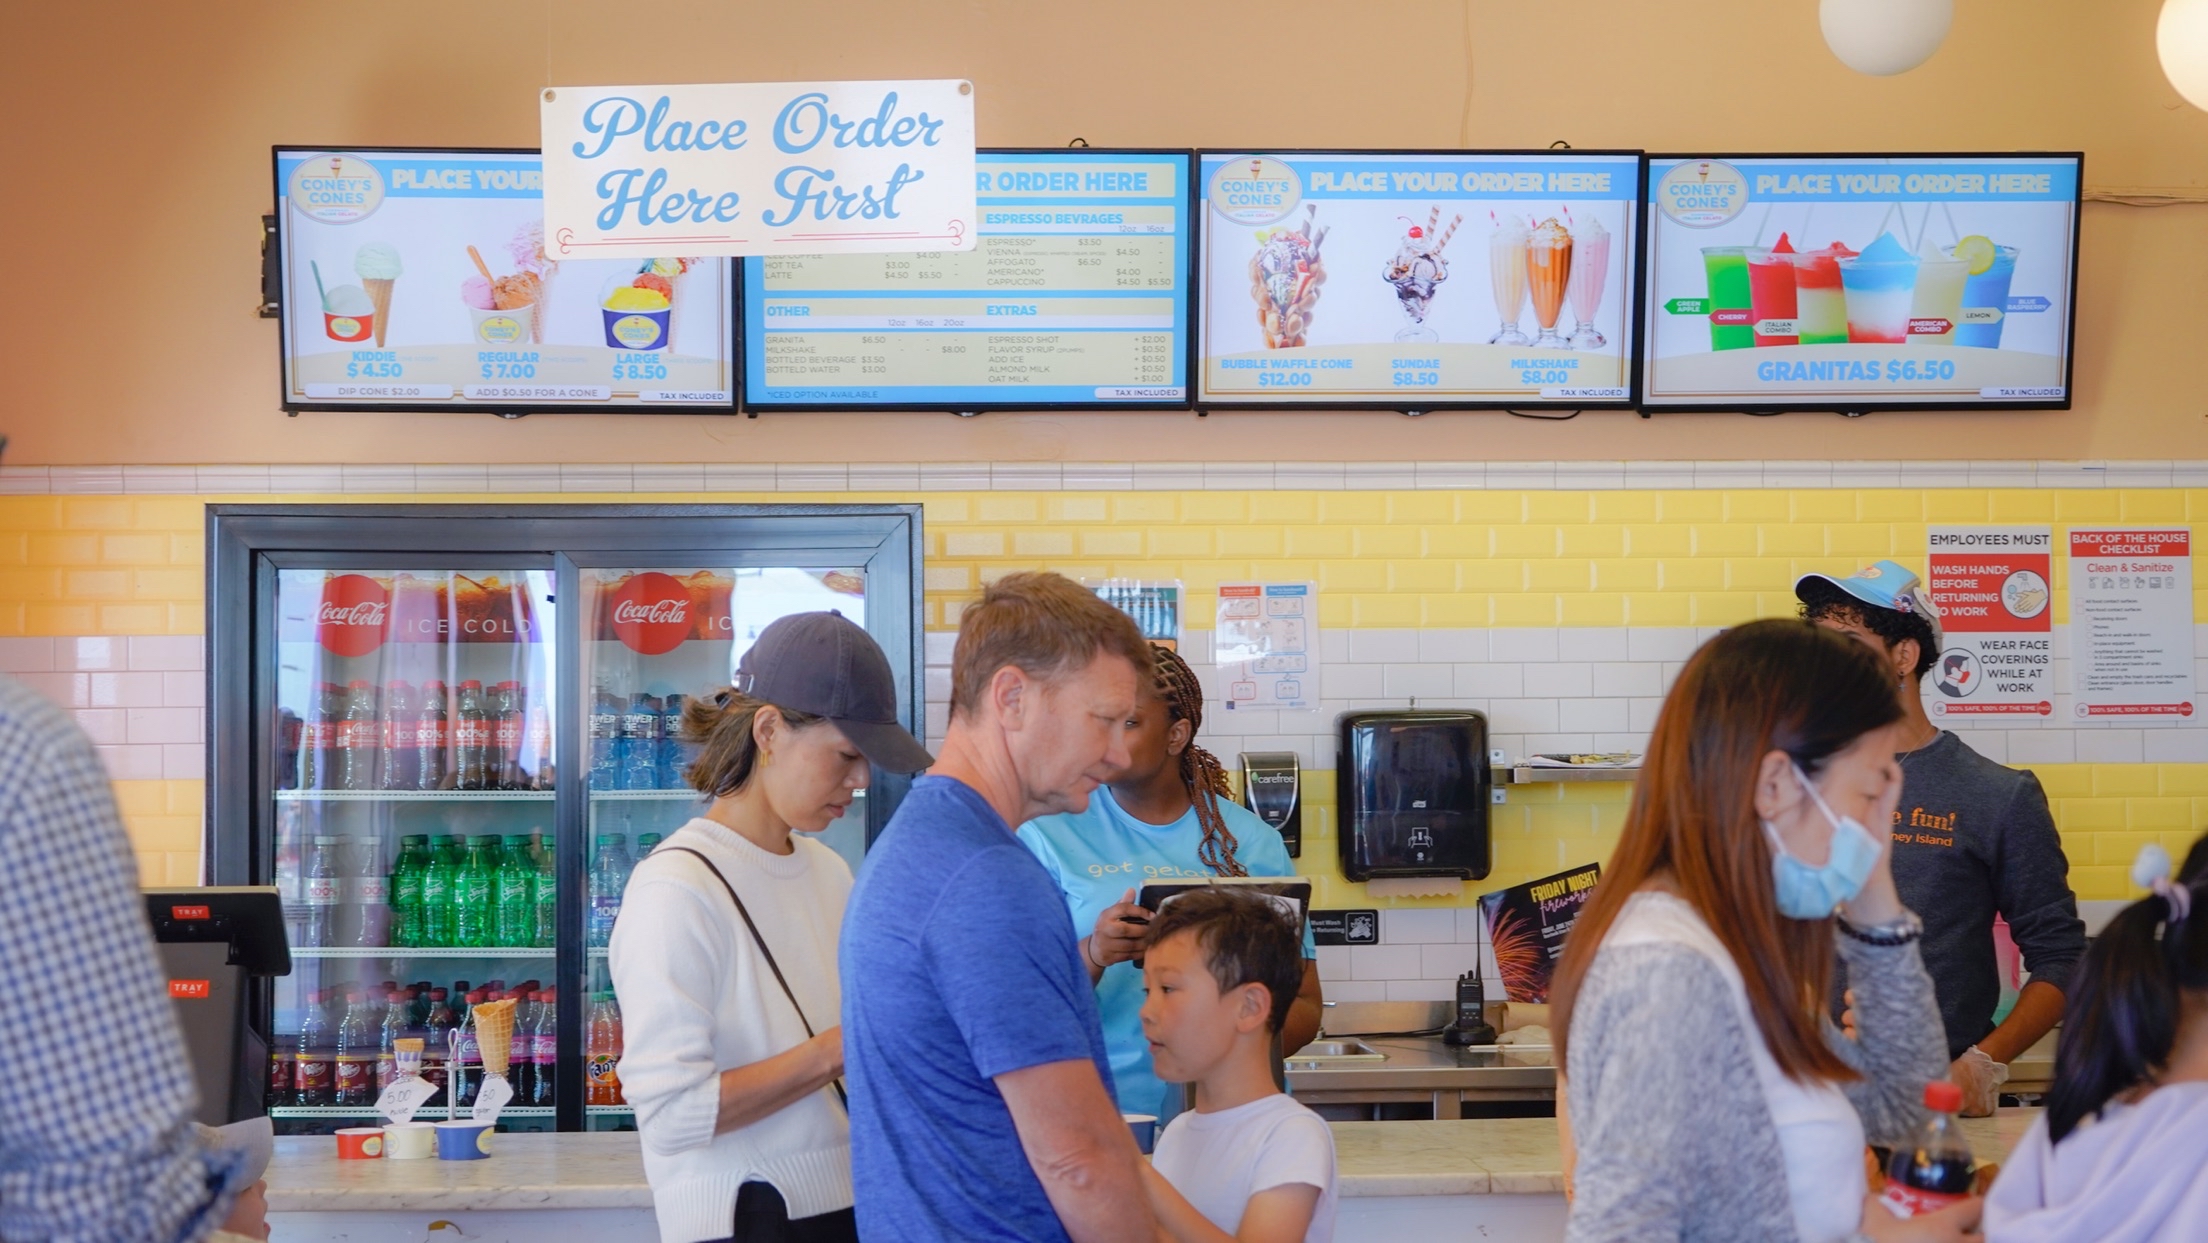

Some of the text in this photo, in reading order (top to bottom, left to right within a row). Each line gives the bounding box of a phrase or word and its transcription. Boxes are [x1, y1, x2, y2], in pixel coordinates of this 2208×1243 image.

[572, 91, 943, 159] Place Order
[392, 169, 472, 190] PLACE
[997, 172, 1080, 192] ORDER
[1085, 172, 1148, 191] HERE
[1311, 171, 1611, 192] PLACE YOUR ORDER HERE
[1757, 174, 2051, 194] PLACE YOUR ORDER HERE
[301, 179, 372, 191] CONEY'S
[1221, 181, 1289, 192] CONEY'S
[1669, 184, 1737, 195] CONEY'S
[309, 192, 365, 204] CONES
[597, 163, 924, 231] Here First
[1228, 194, 1282, 205] CONES
[1676, 197, 1729, 208] CONES
[986, 213, 1123, 224] ESPRESSO BEVRAGES
[1078, 238, 1101, 247] $3.50
[1116, 248, 1140, 256] $4.50
[885, 261, 910, 269] $3.00
[987, 258, 1101, 266] AFFOGATO $6.50
[885, 271, 909, 279] $4.50
[918, 271, 942, 279] $5.50
[1116, 268, 1141, 276] $4.00
[987, 278, 1045, 286] CAPPUCCINO
[767, 306, 810, 316] OTHER
[987, 305, 1037, 315] EXTRAS
[765, 336, 886, 344] GRANITA $6.50
[988, 336, 1166, 344] ESPRESSO SHOT $2.00
[766, 346, 966, 354] MILKSHAKE $8.00
[988, 346, 1054, 354] FLAVOR SYRUP
[353, 351, 397, 362] KIDDIE
[478, 352, 539, 363] REGULAR
[616, 353, 660, 364] LARGE
[766, 356, 885, 364] BOTTLED BEVERAGE $3.50
[988, 365, 1050, 373] ALMOND MILK
[1221, 359, 1353, 369] BUBBLE WAFFLE CONE
[1391, 359, 1440, 369] SUNDAE
[1511, 359, 1579, 369] MILKSHAKE
[347, 363, 403, 378] $ 4.50
[481, 363, 535, 379] $ 7.00
[612, 364, 667, 381] $ 8.50
[766, 366, 886, 374] BOTTELD WATER $3.00
[1758, 358, 1955, 383] GRANITAS $6.50
[988, 375, 1029, 383] OAT MILK
[1258, 372, 1312, 387] $12.00
[1393, 372, 1439, 387] $8.50
[1521, 370, 1568, 385] $8.00
[338, 387, 420, 396] DIP CONE $2.00
[476, 388, 598, 397] ADD $0.50 FOR A CONE
[793, 391, 878, 399] OPTION AVAILABLE
[1930, 535, 2049, 545] EMPLOYEES MUST
[2072, 534, 2187, 543] BACK OF THE HOUSE
[2100, 545, 2160, 554] CHECKLIST
[1932, 566, 2010, 575] WASH HANDS
[2087, 563, 2174, 573] Clean & Sanitize
[1933, 580, 1978, 589] BEFORE
[1933, 593, 1999, 602] RETURNING
[316, 600, 389, 626] Coca-Cola
[614, 599, 690, 625] Coca-Cola
[1952, 607, 1988, 616] WORK
[408, 619, 533, 633] ICE COLD
[1980, 641, 2049, 649] WEAR FACE
[1981, 655, 2048, 664] COVERINGS
[1987, 669, 2043, 678] WHILE AT
[1997, 684, 2034, 692] WORK
[1258, 772, 1294, 784] carefree
[1910, 807, 1956, 831] fun!
[1916, 833, 1953, 847] Island
[1088, 861, 1133, 878] got
[1530, 870, 1598, 903] FRIDAY NIGHT
[178, 909, 203, 917] TRAY
[175, 984, 203, 993] TRAY
